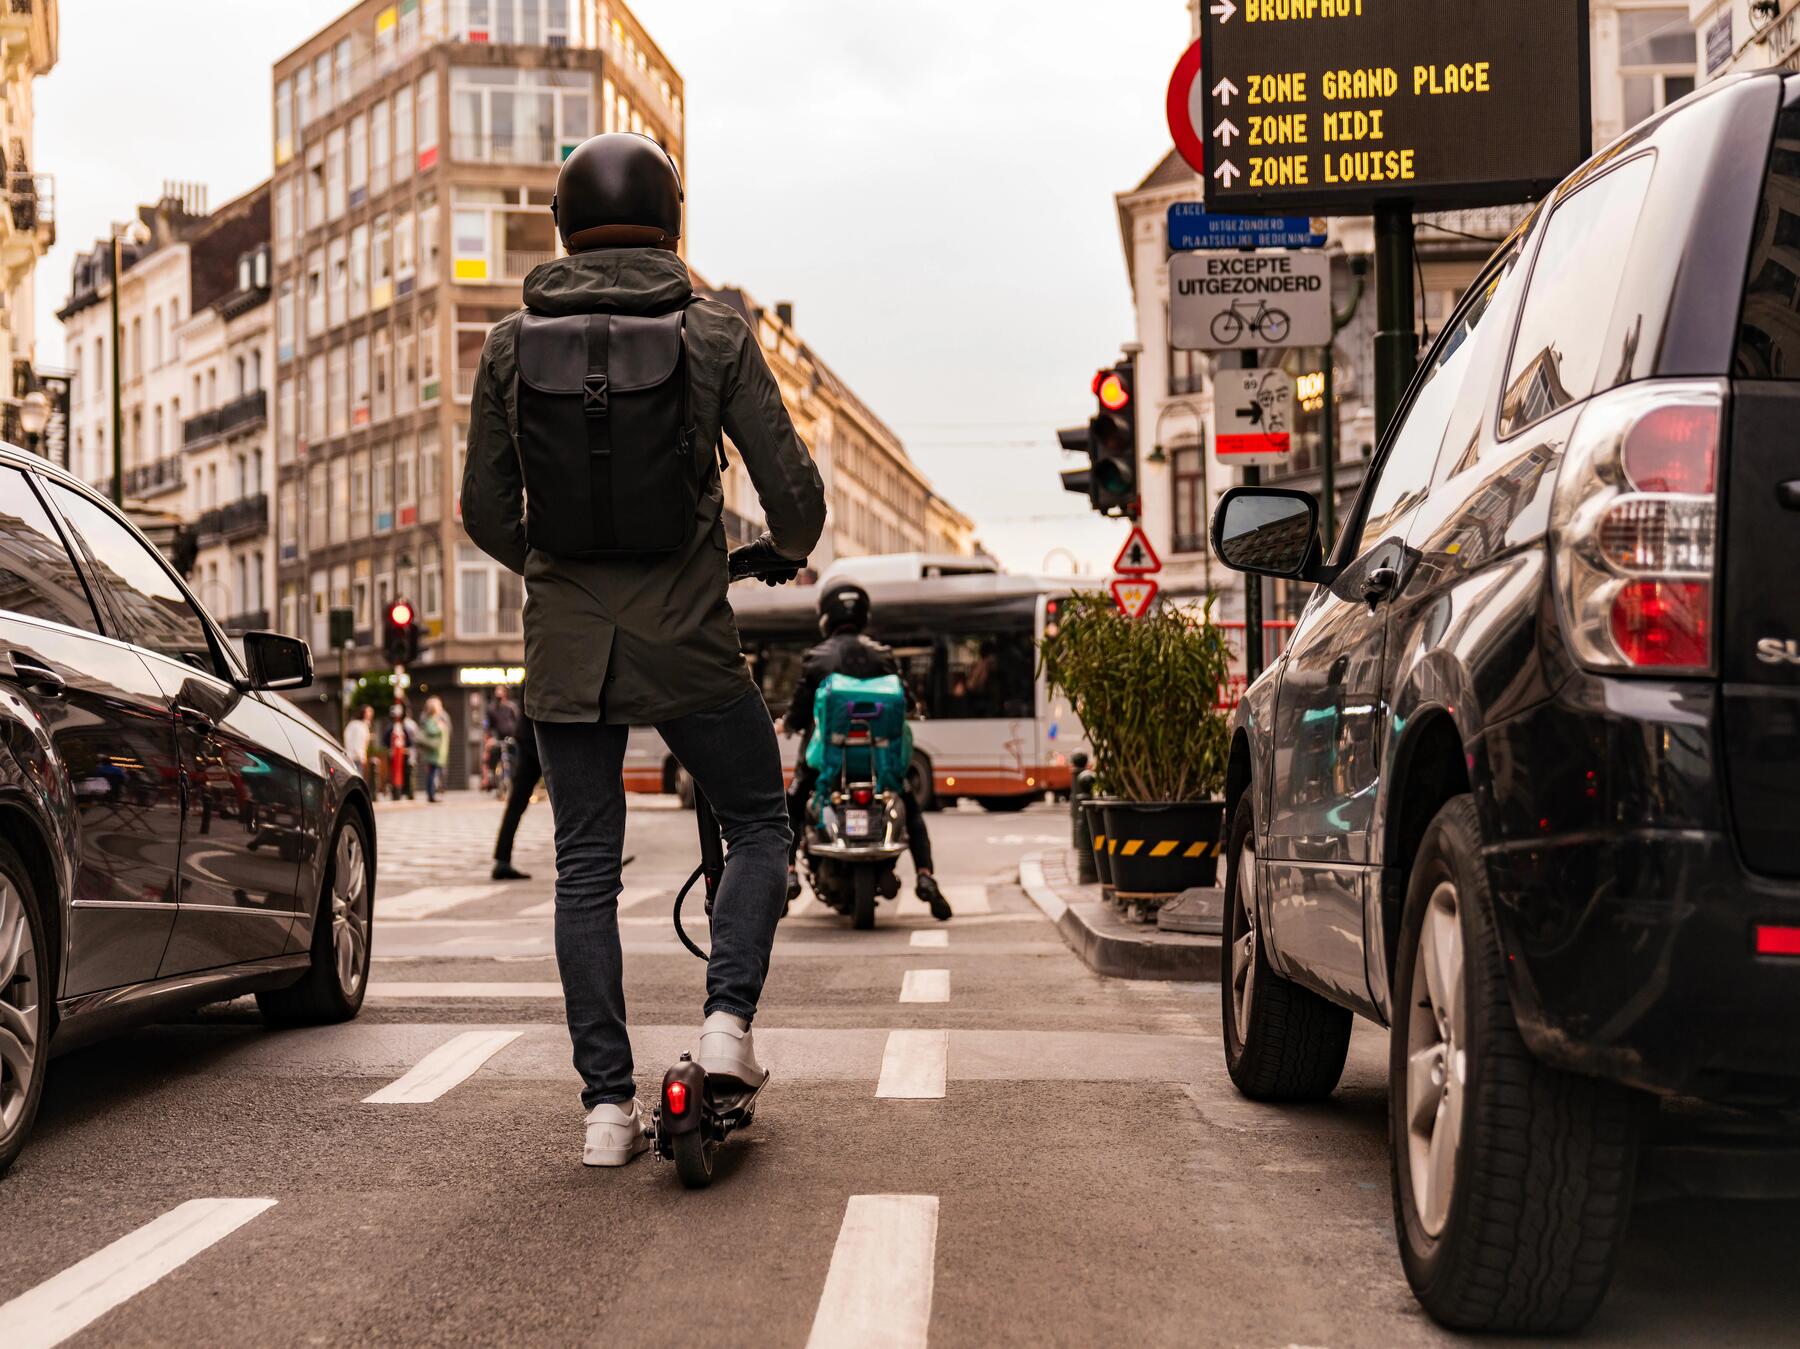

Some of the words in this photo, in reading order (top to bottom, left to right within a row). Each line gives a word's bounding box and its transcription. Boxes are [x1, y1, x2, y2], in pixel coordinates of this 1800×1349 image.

[1247, 73, 1307, 104] ZONE
[1322, 67, 1398, 100] GRAND
[1413, 62, 1490, 95] PLACE
[1248, 113, 1308, 145] ZONE
[1323, 109, 1383, 142] MIDI
[1249, 155, 1308, 187] ZONE
[1324, 149, 1415, 183] LOUISE
[1209, 218, 1285, 232] UITGEZONDERD
[1182, 234, 1252, 247] PLAATSELIJKE
[1258, 233, 1312, 246] BEDIENING
[1207, 257, 1292, 275] EXCEPTE
[1178, 275, 1322, 296] UITGEZONDERD
